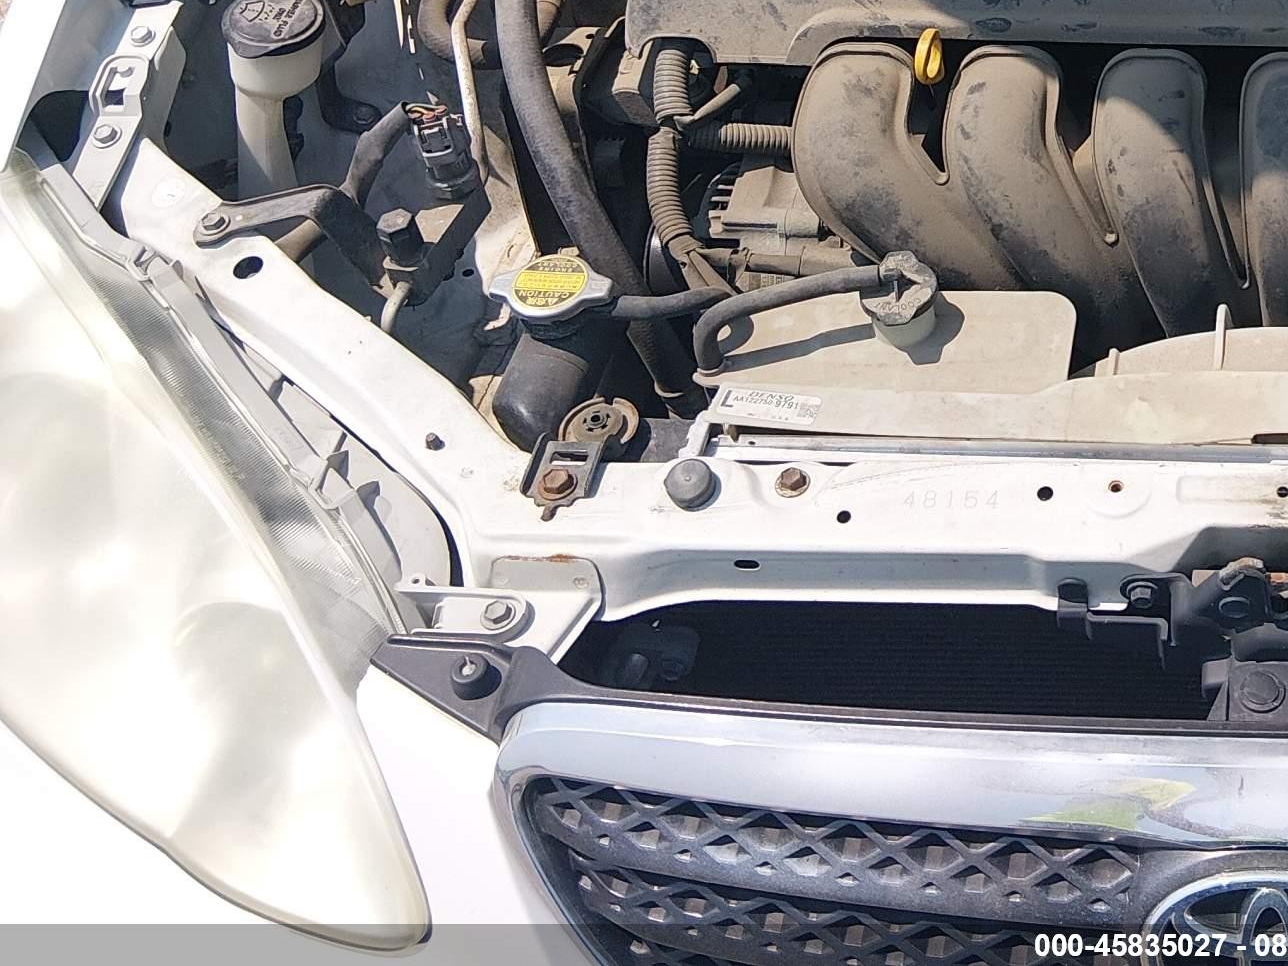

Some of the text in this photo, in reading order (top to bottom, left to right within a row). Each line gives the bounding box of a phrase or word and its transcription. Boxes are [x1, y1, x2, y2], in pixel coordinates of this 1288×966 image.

[518, 289, 570, 298] CAUTION
[719, 389, 796, 408] L DENSO
[903, 490, 1001, 509] 48154
